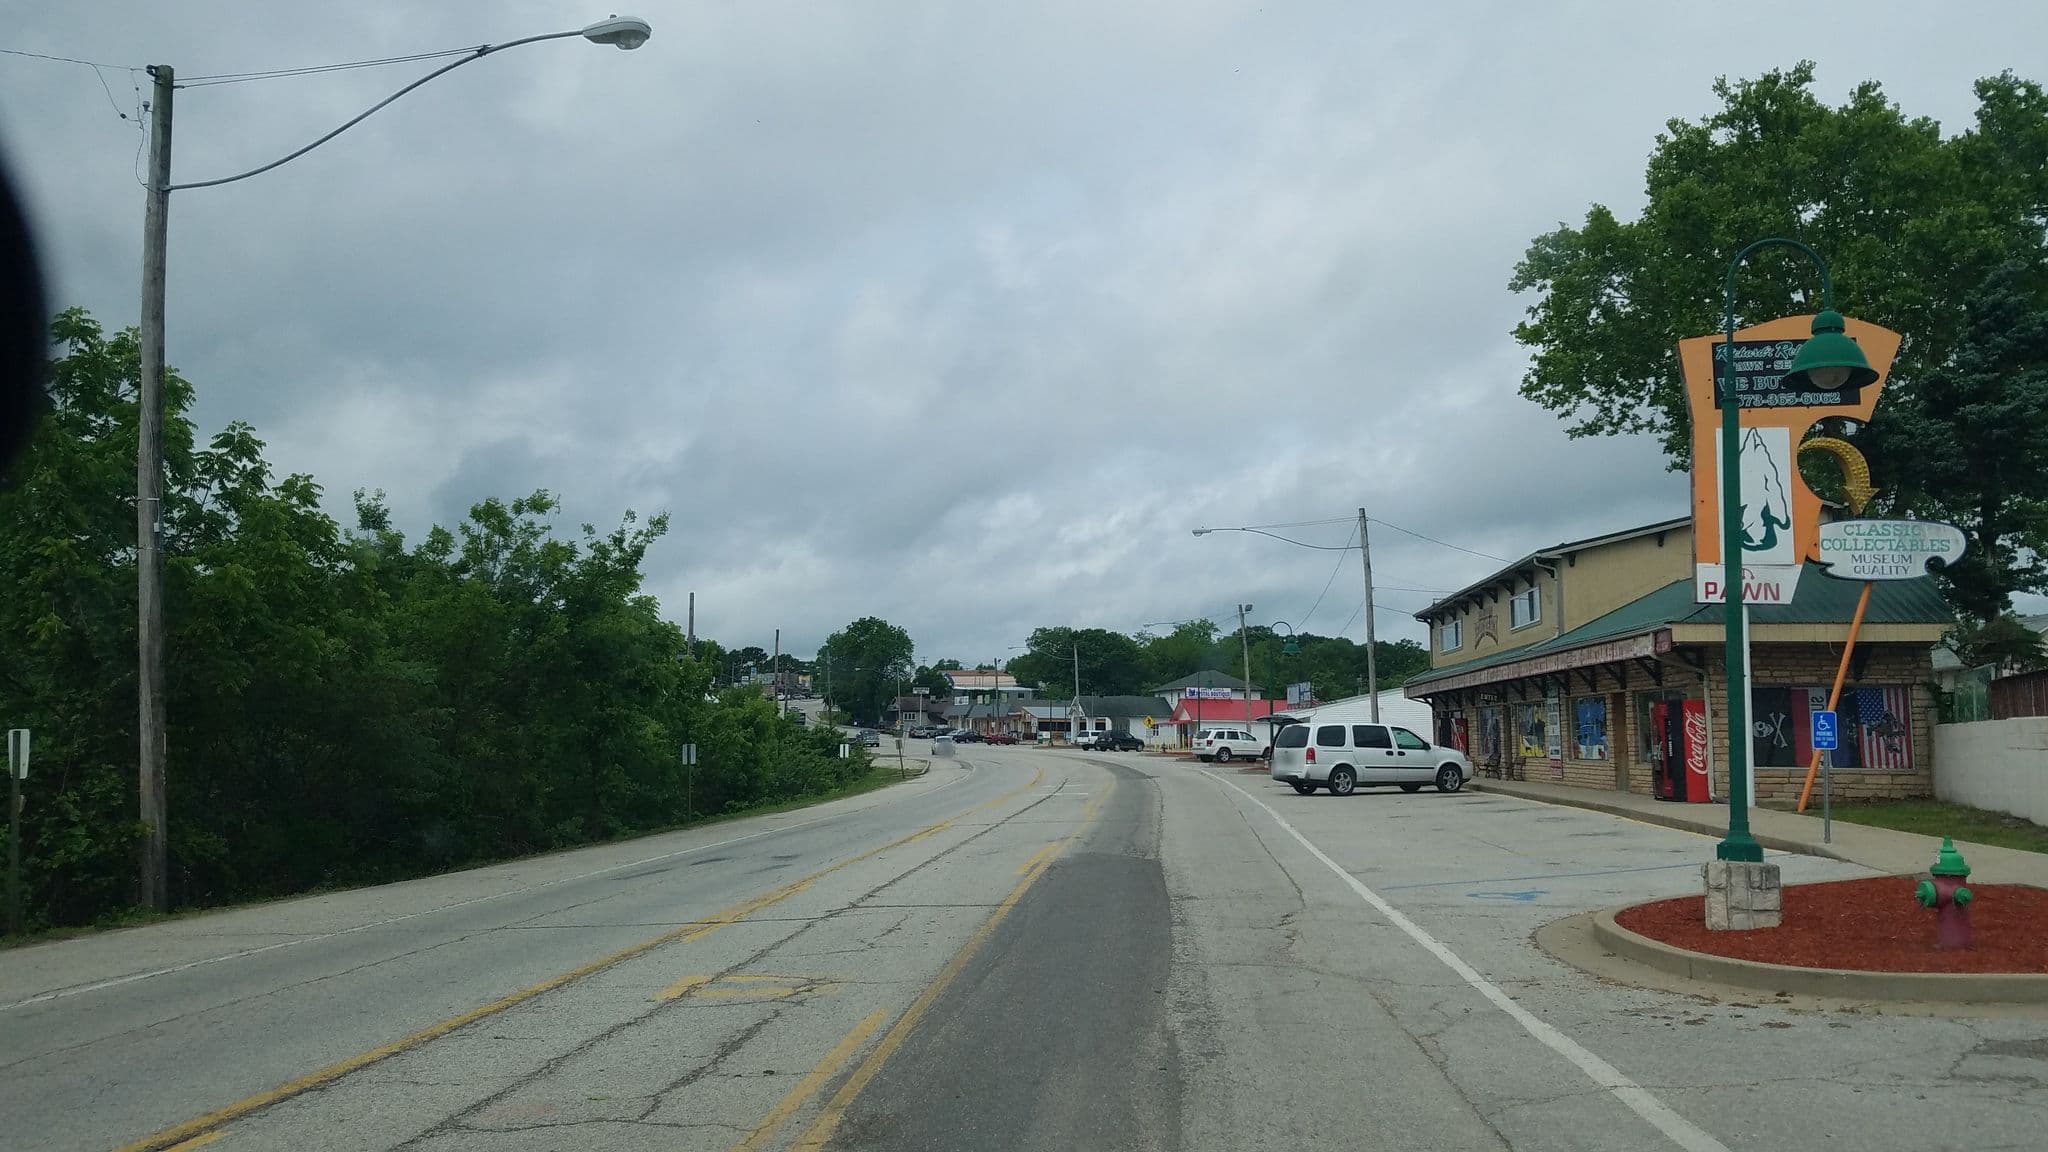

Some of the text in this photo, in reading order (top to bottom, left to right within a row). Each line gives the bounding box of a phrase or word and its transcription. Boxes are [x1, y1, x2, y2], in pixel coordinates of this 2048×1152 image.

[1716, 343, 1774, 362] Rchard's
[1733, 360, 1763, 372] AWN
[1773, 359, 1793, 371] SE
[1843, 523, 1921, 537] CLASSIC
[1820, 538, 1951, 553] COLLECTABLES
[1851, 553, 1913, 565] MUSEUM
[1853, 565, 1911, 576] QUALITY
